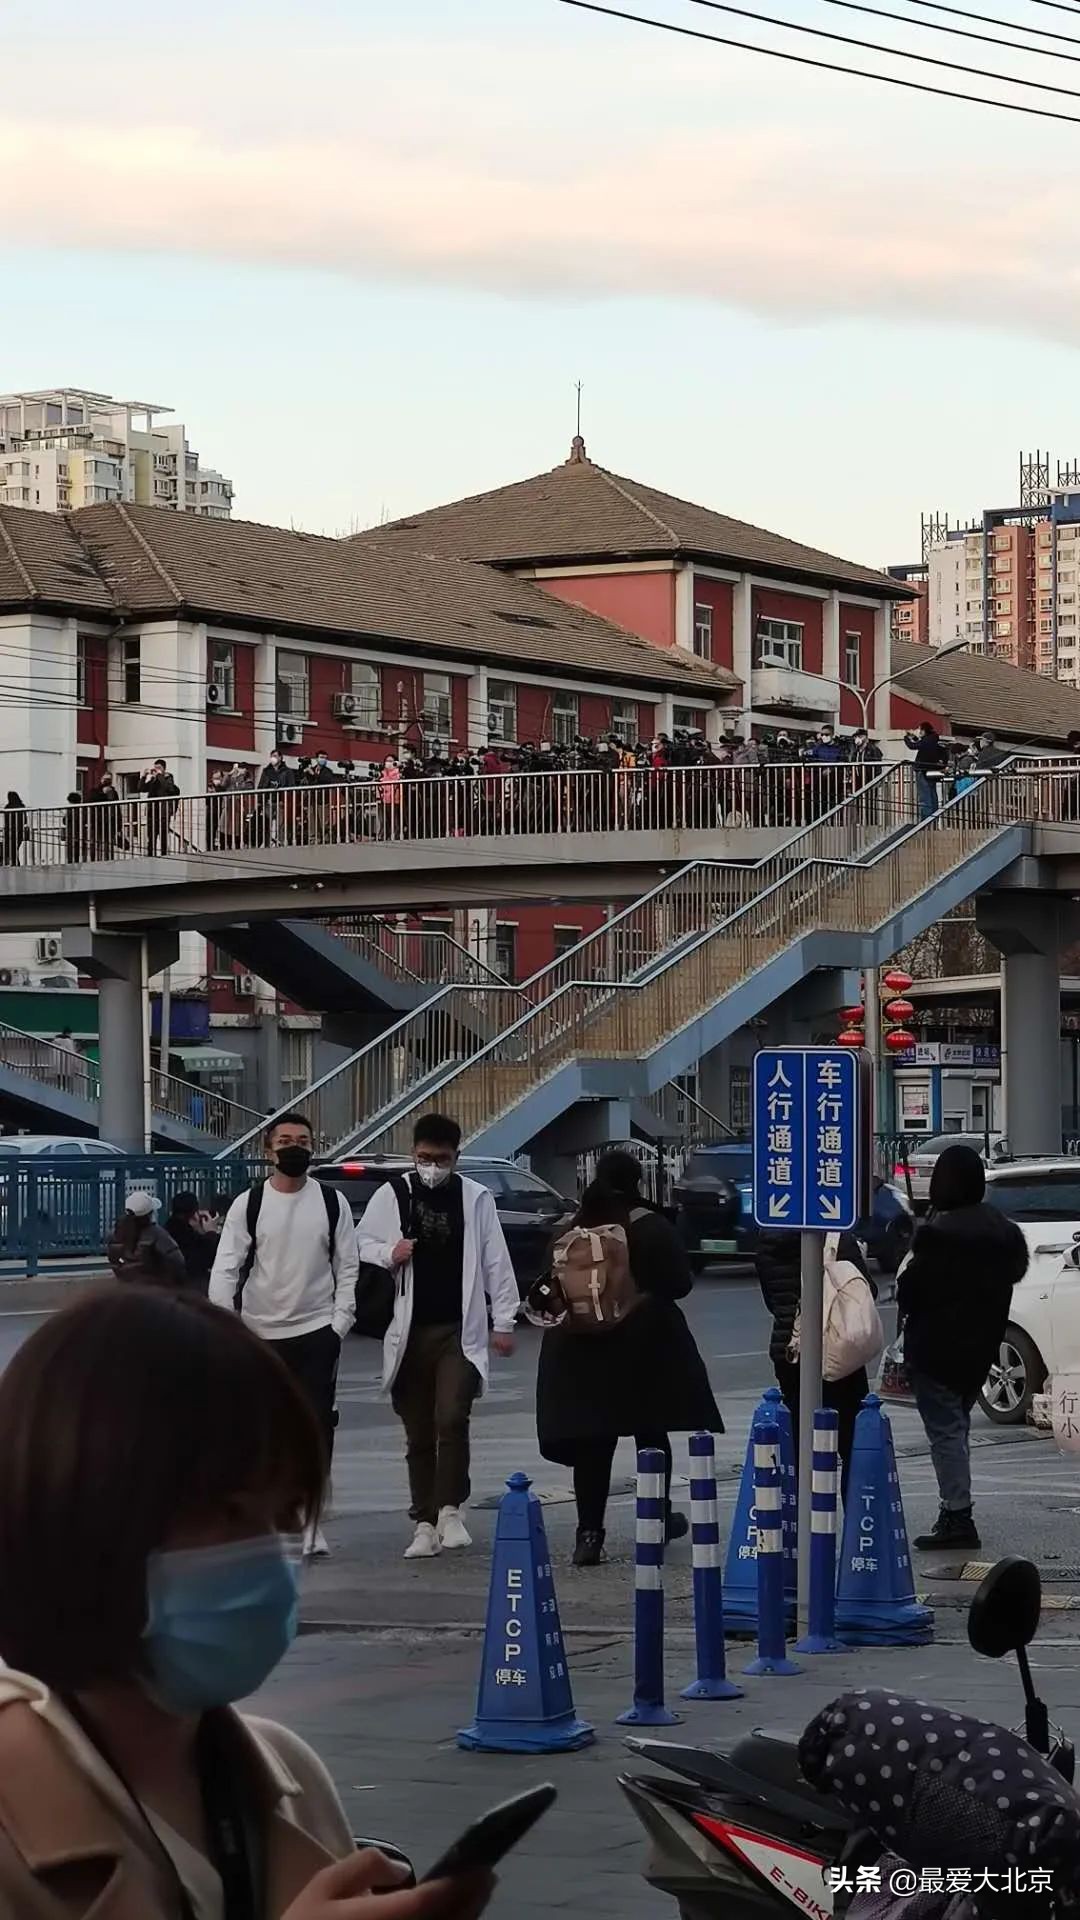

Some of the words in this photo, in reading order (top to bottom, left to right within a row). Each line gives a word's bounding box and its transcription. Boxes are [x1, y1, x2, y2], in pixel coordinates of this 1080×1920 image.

[767, 1059, 793, 1186] 人行通道
[817, 1059, 843, 1188] 车行通道
[851, 1557, 878, 1571] 停车
[505, 1568, 522, 1662] ETCP
[495, 1668, 527, 1686] 停车
